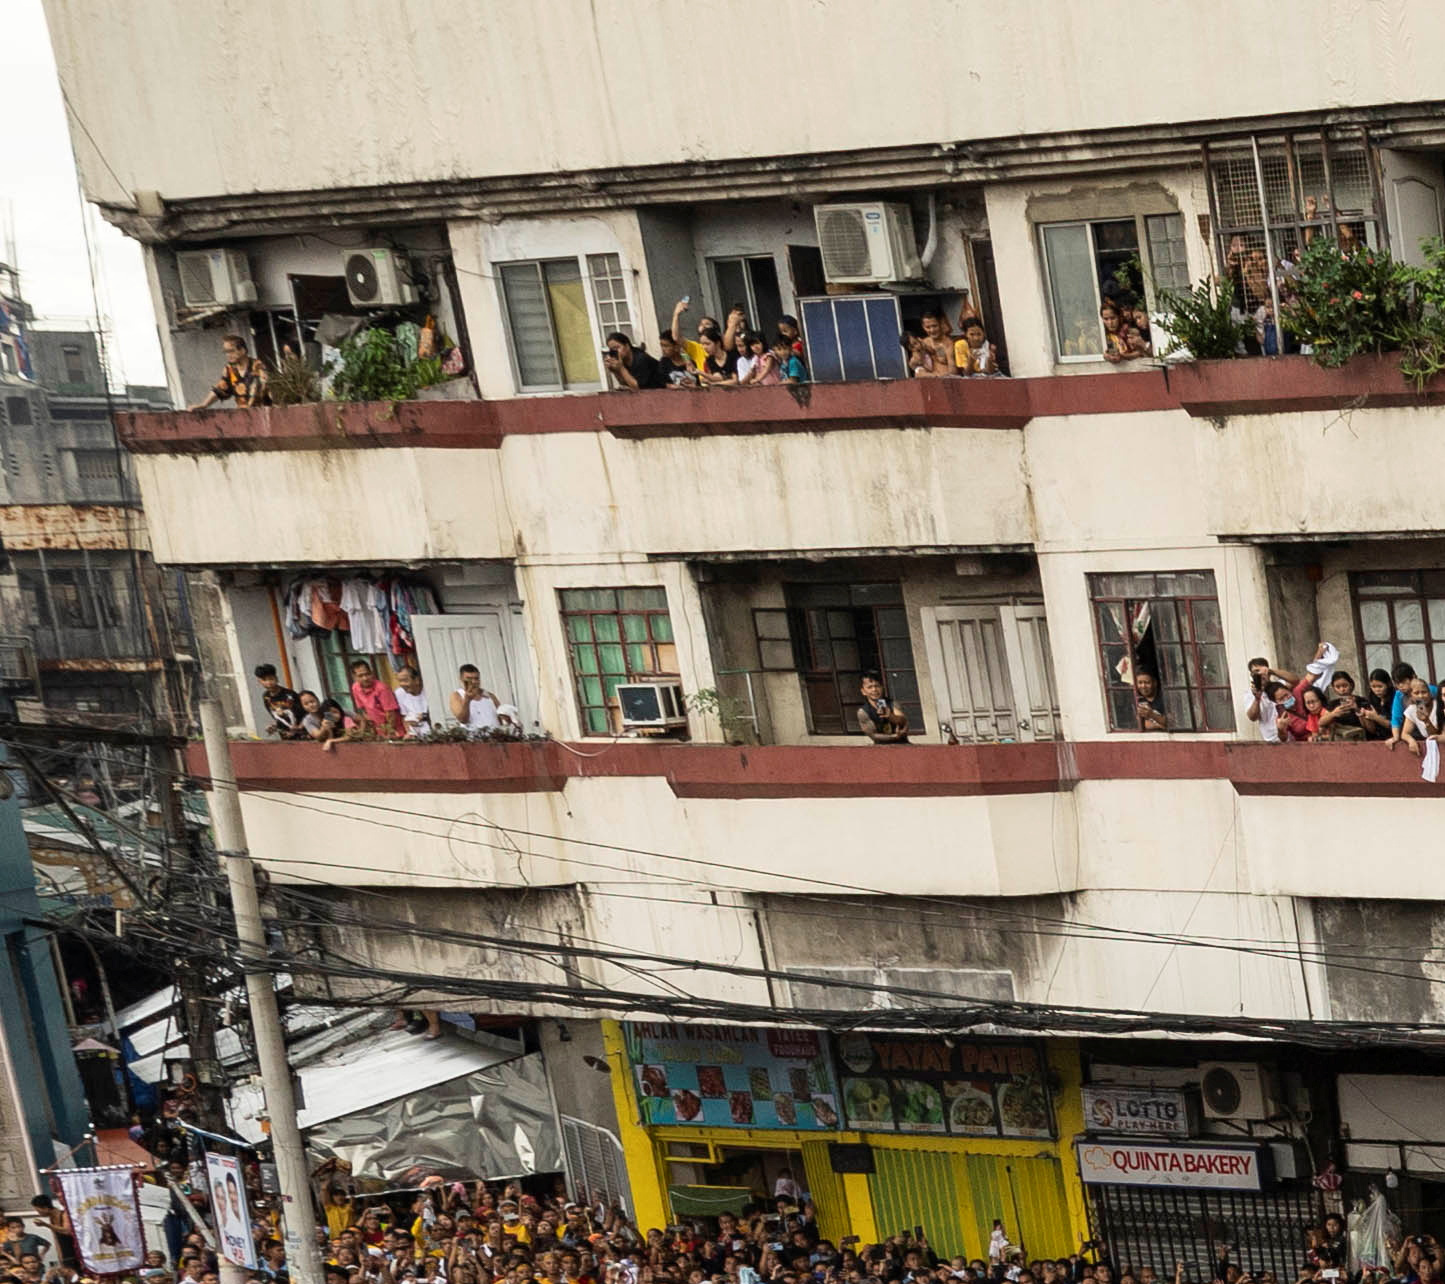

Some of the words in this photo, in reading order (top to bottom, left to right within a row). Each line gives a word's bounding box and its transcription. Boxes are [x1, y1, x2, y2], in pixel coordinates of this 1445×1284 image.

[1116, 1101, 1178, 1121] LOTTO
[1113, 1151, 1183, 1174] QUINTA
[1184, 1154, 1252, 1176] BAKERY
